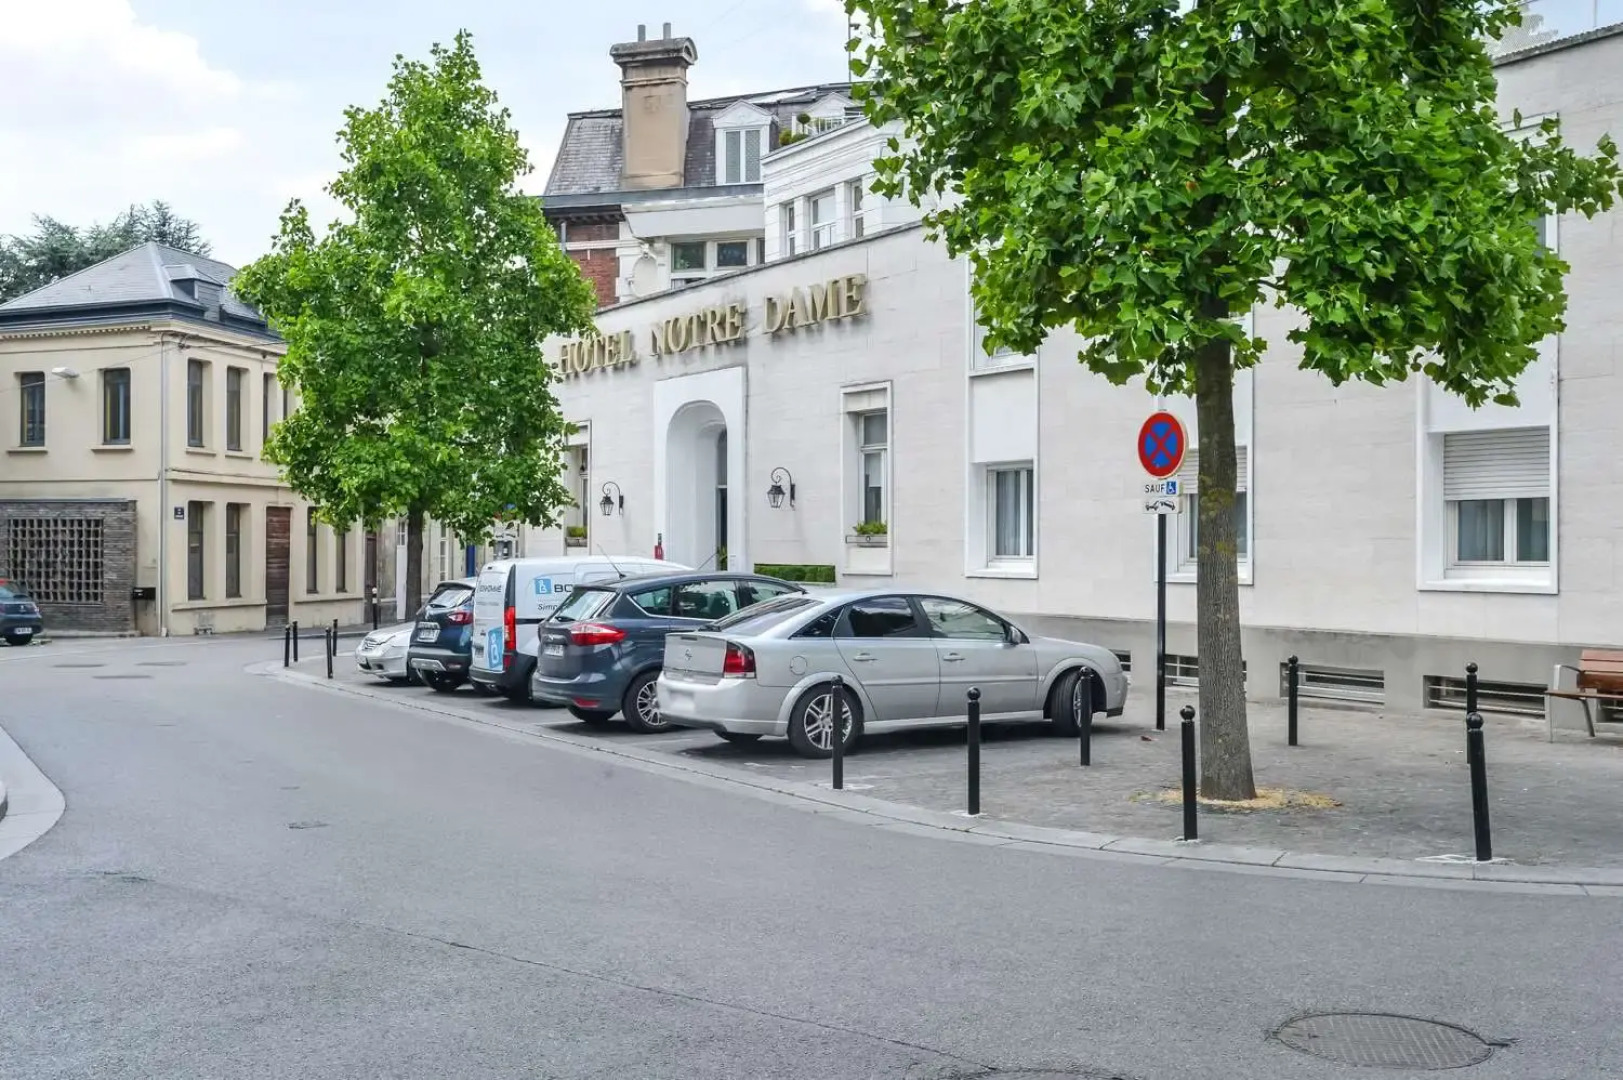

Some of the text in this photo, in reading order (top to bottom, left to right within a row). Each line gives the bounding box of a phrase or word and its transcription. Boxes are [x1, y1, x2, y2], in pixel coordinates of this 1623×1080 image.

[650, 302, 746, 356] NOTRE
[763, 273, 868, 333] DAME
[1145, 484, 1166, 494] SAUF
